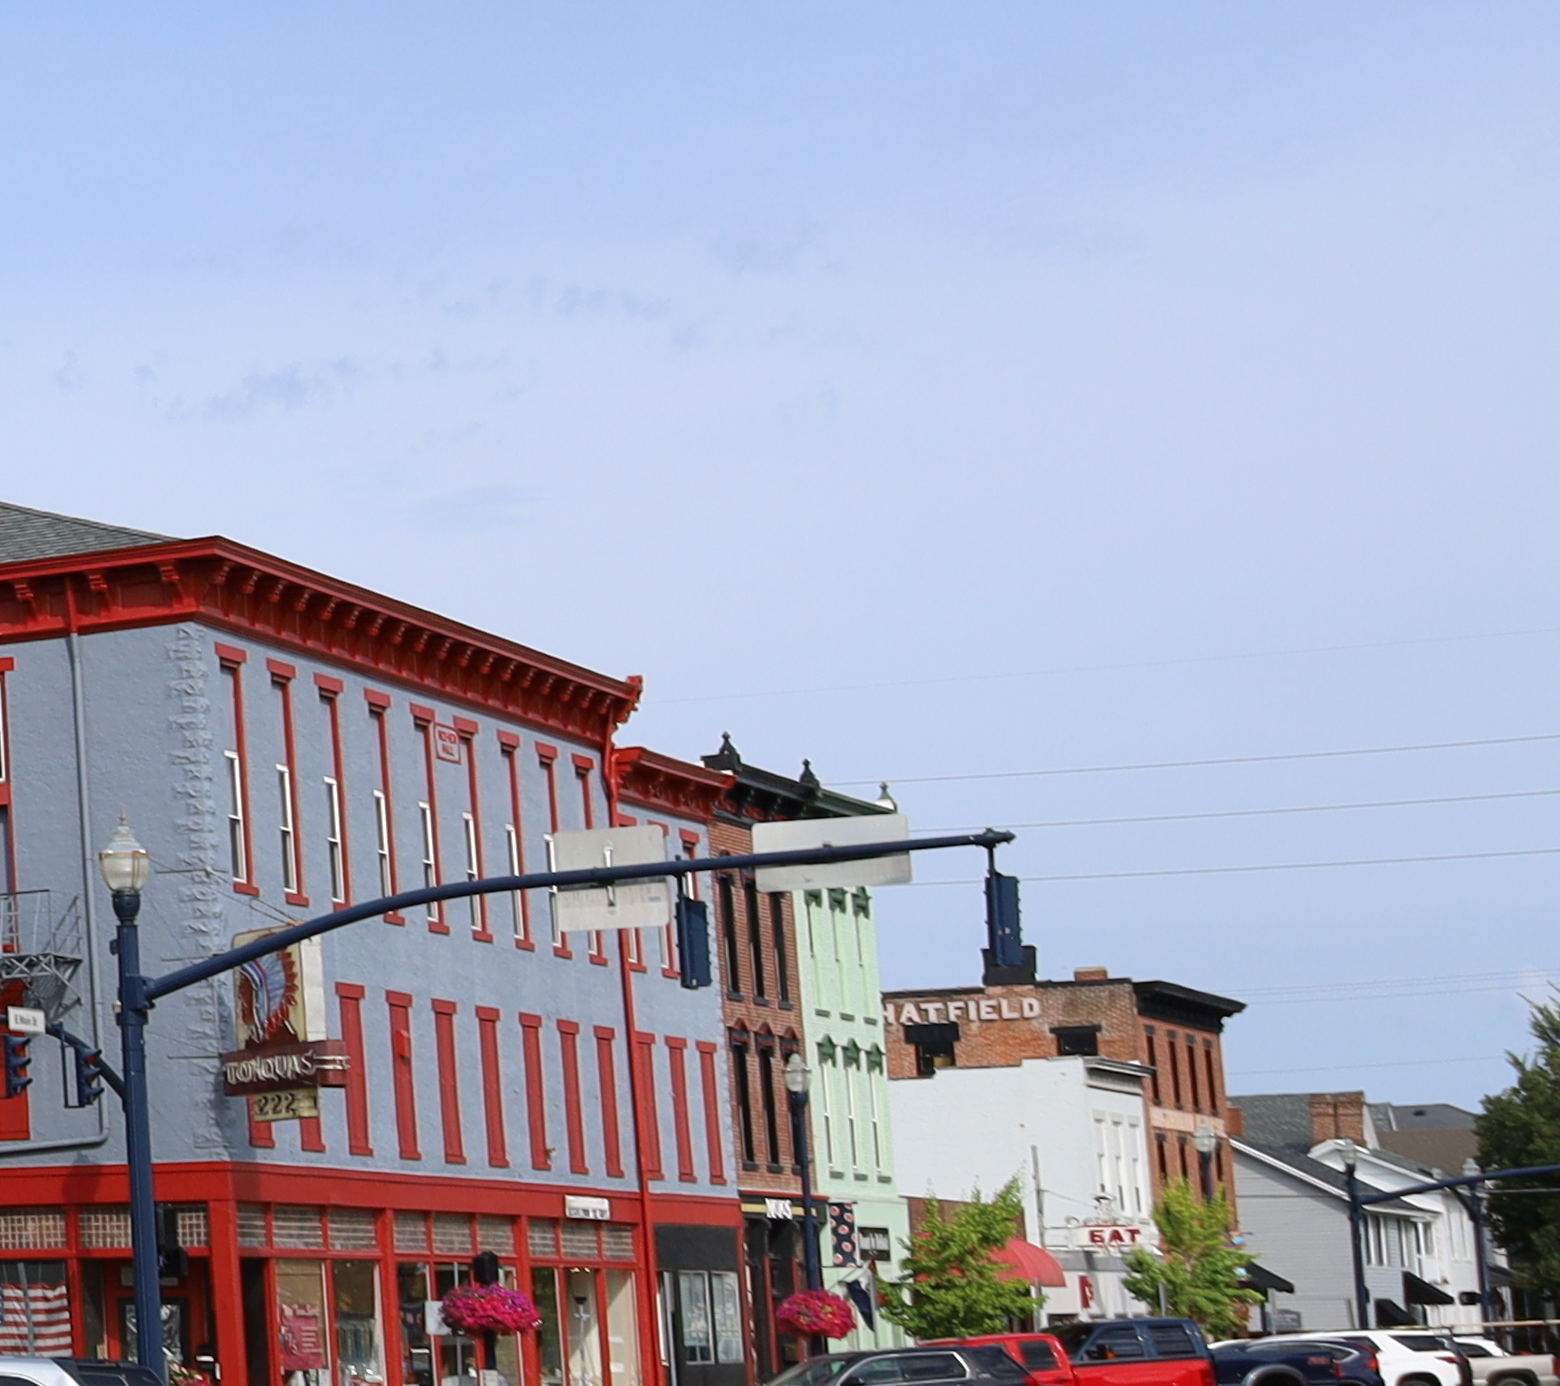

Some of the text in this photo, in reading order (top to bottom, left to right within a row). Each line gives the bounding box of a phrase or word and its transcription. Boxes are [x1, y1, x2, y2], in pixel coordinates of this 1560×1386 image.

[882, 996, 1041, 1025] HATFIELD
[255, 1093, 297, 1116] 222
[1088, 1229, 1141, 1243] EAT
